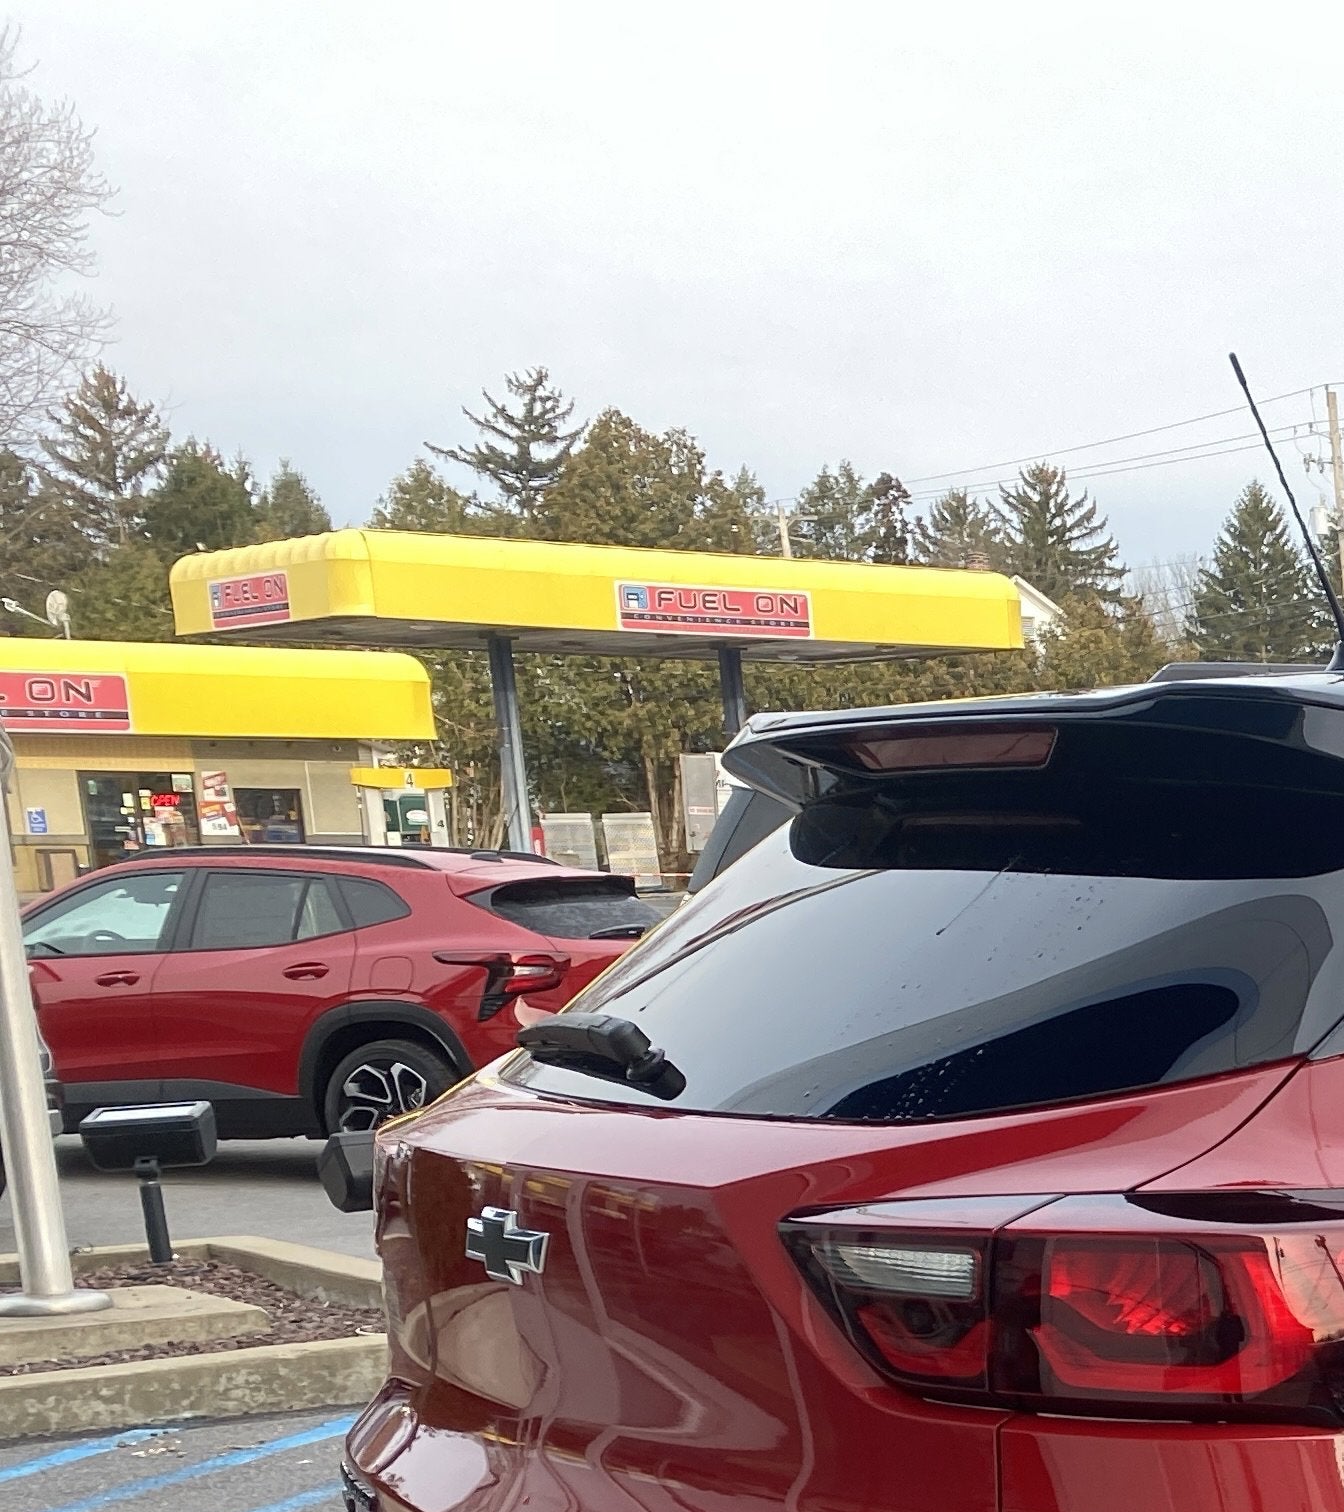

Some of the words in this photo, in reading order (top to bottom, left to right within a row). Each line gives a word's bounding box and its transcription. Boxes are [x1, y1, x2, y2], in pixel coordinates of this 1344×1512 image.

[655, 589, 742, 613] FUEL
[754, 594, 800, 615] ON
[633, 613, 742, 626] CONVENIENCE
[750, 619, 797, 628] STORE
[26, 679, 93, 703] ON
[406, 773, 414, 785] 4
[150, 794, 180, 807] OPEN
[437, 819, 445, 829] 4
